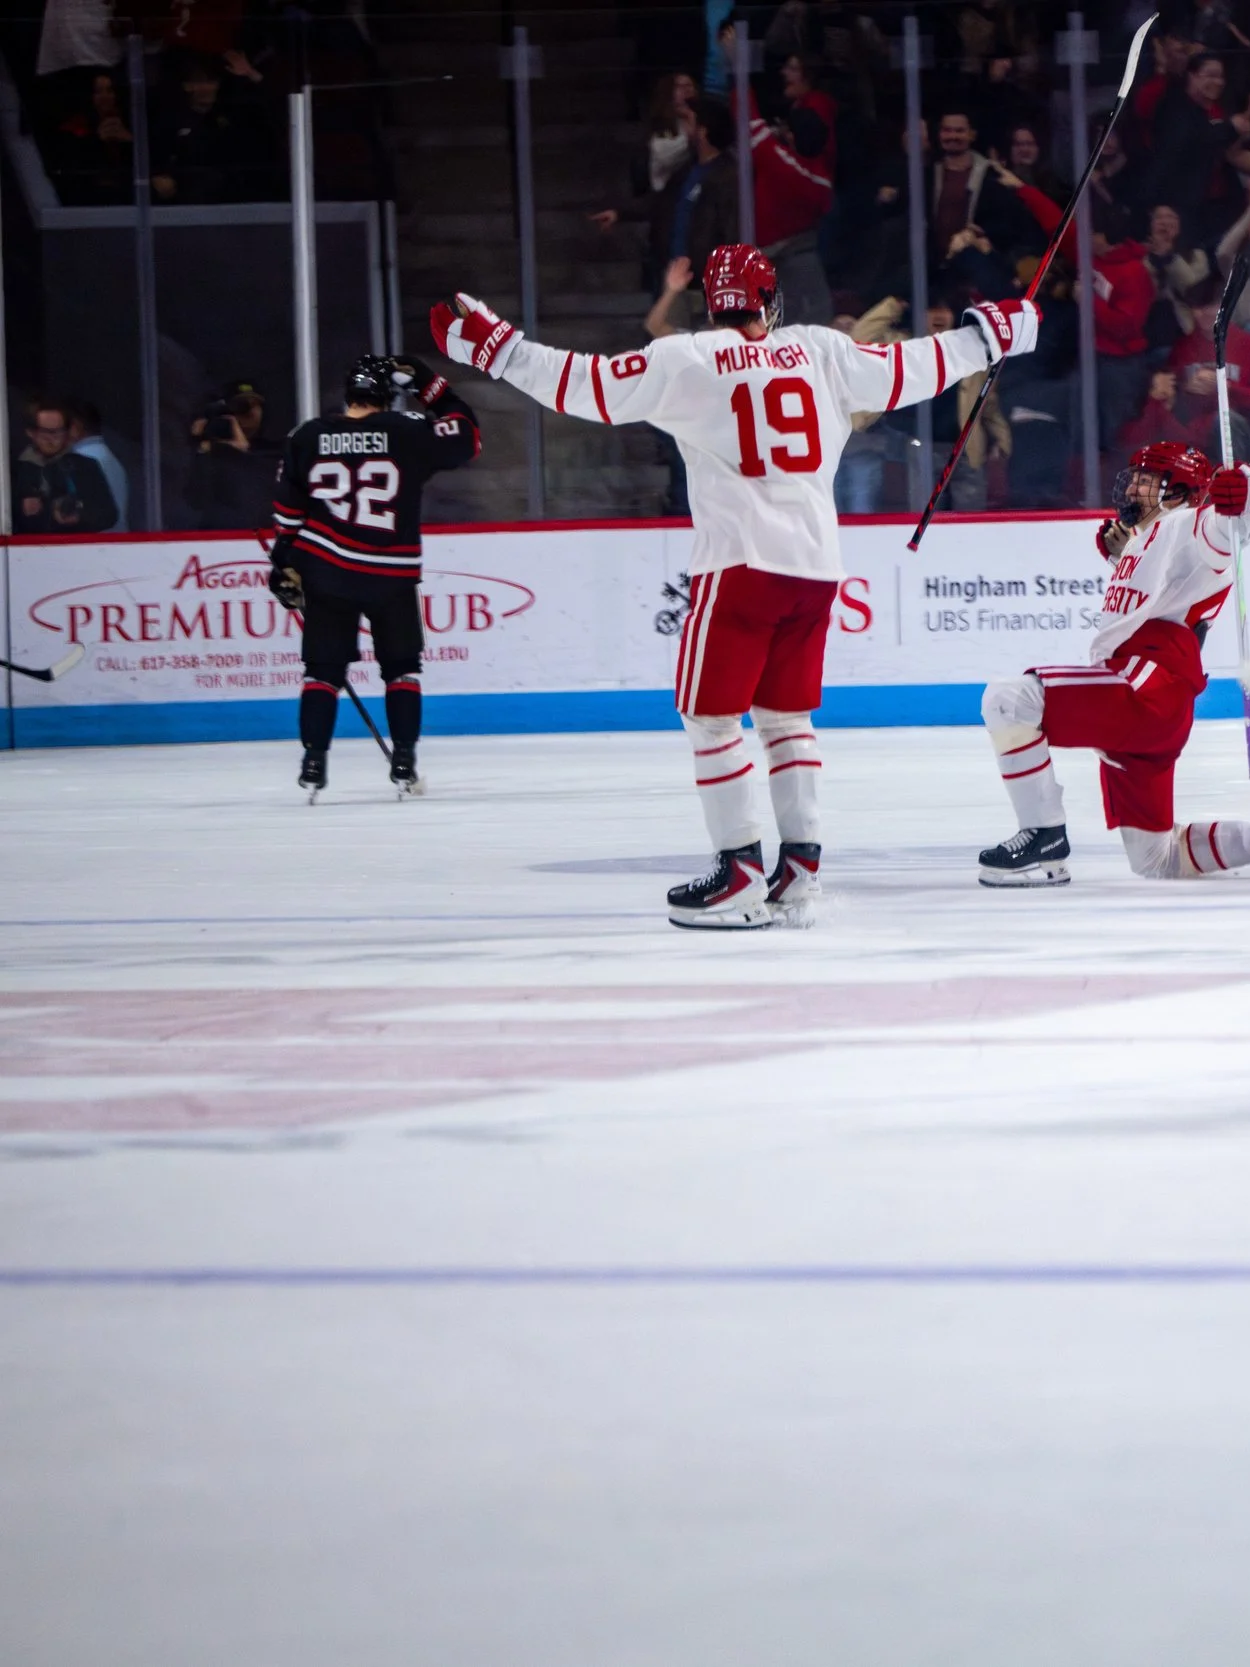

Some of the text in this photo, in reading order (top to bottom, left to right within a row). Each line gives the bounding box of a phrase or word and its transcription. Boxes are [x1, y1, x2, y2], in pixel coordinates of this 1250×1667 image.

[715, 344, 810, 376] MURTAGH
[730, 377, 823, 478] 19
[318, 432, 389, 455] BORGESI
[308, 459, 399, 531] 22
[172, 554, 271, 590] AGGAN
[925, 576, 1104, 602] Hingham Street
[1102, 585, 1150, 615] RSITY
[925, 609, 970, 632] UBS
[978, 608, 1070, 631] Financial
[248, 652, 268, 667] OR
[272, 650, 302, 666] EMA
[195, 674, 224, 689] FOR
[228, 671, 264, 687] MORE
